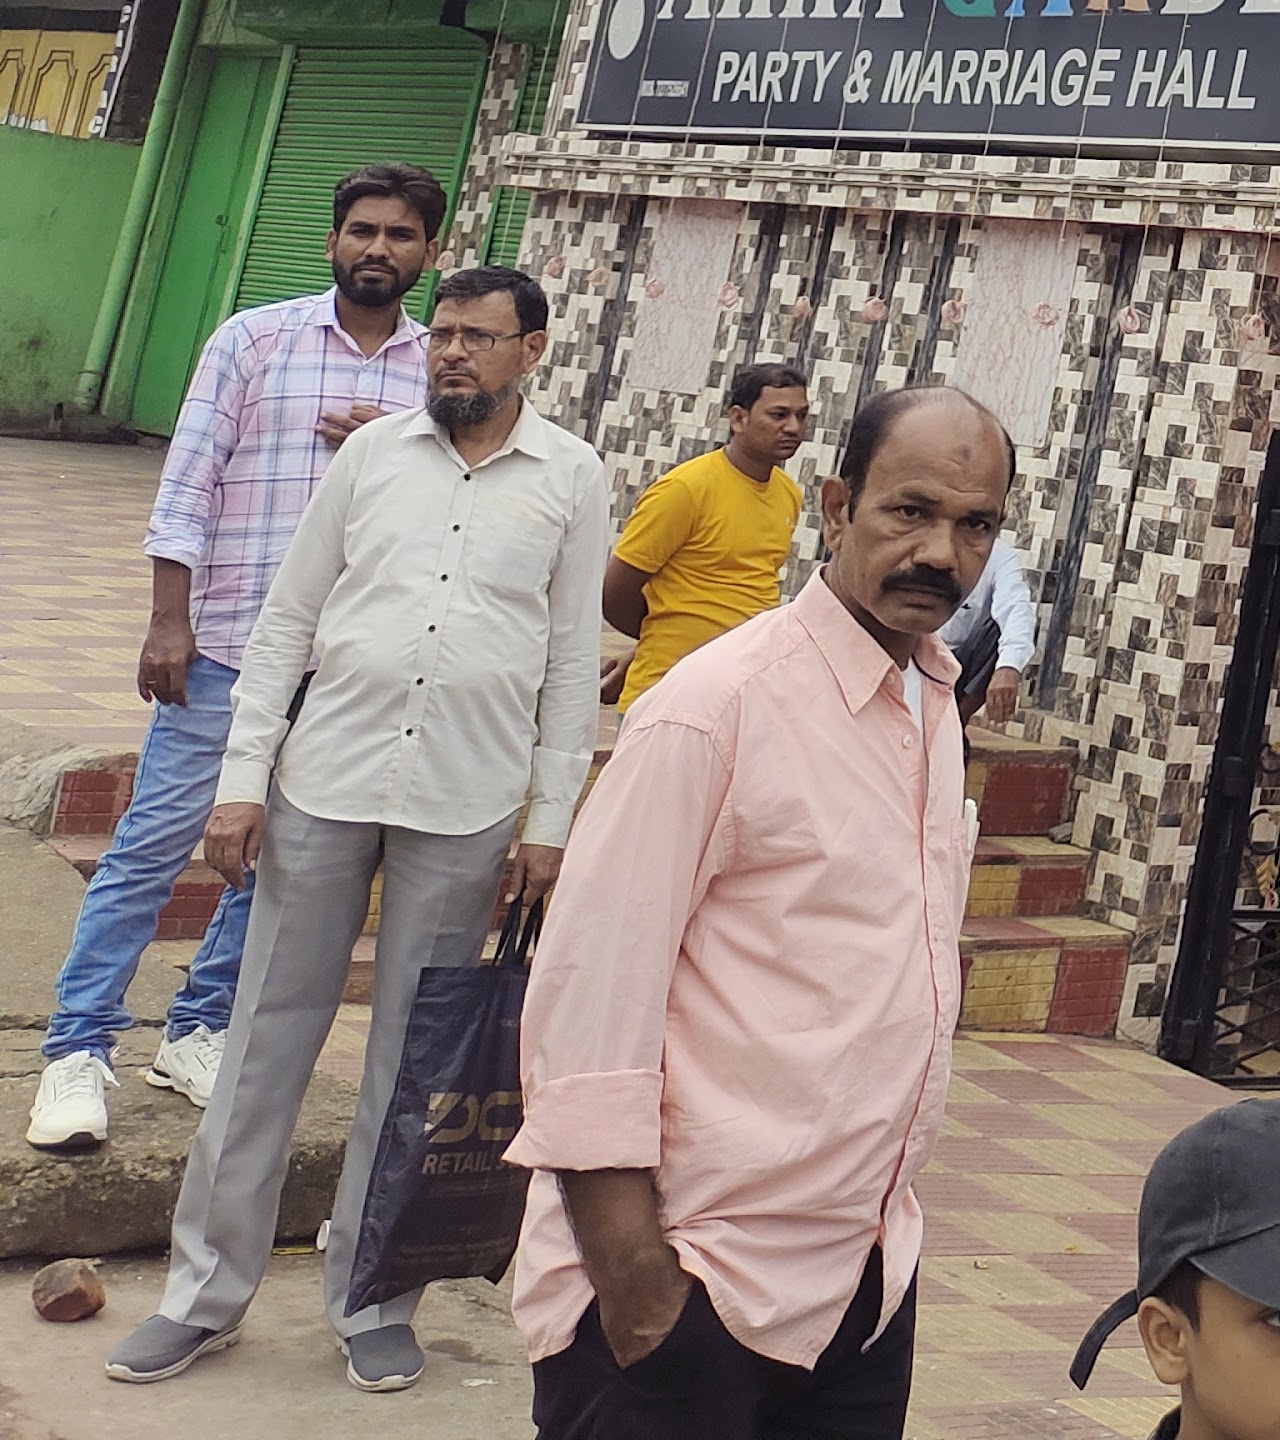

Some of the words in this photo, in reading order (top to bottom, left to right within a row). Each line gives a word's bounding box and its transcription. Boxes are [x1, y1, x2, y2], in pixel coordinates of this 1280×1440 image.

[712, 49, 843, 103] PARTY
[842, 49, 873, 104] &
[880, 48, 1122, 107] MARRIAGE
[1125, 48, 1257, 110] HALL
